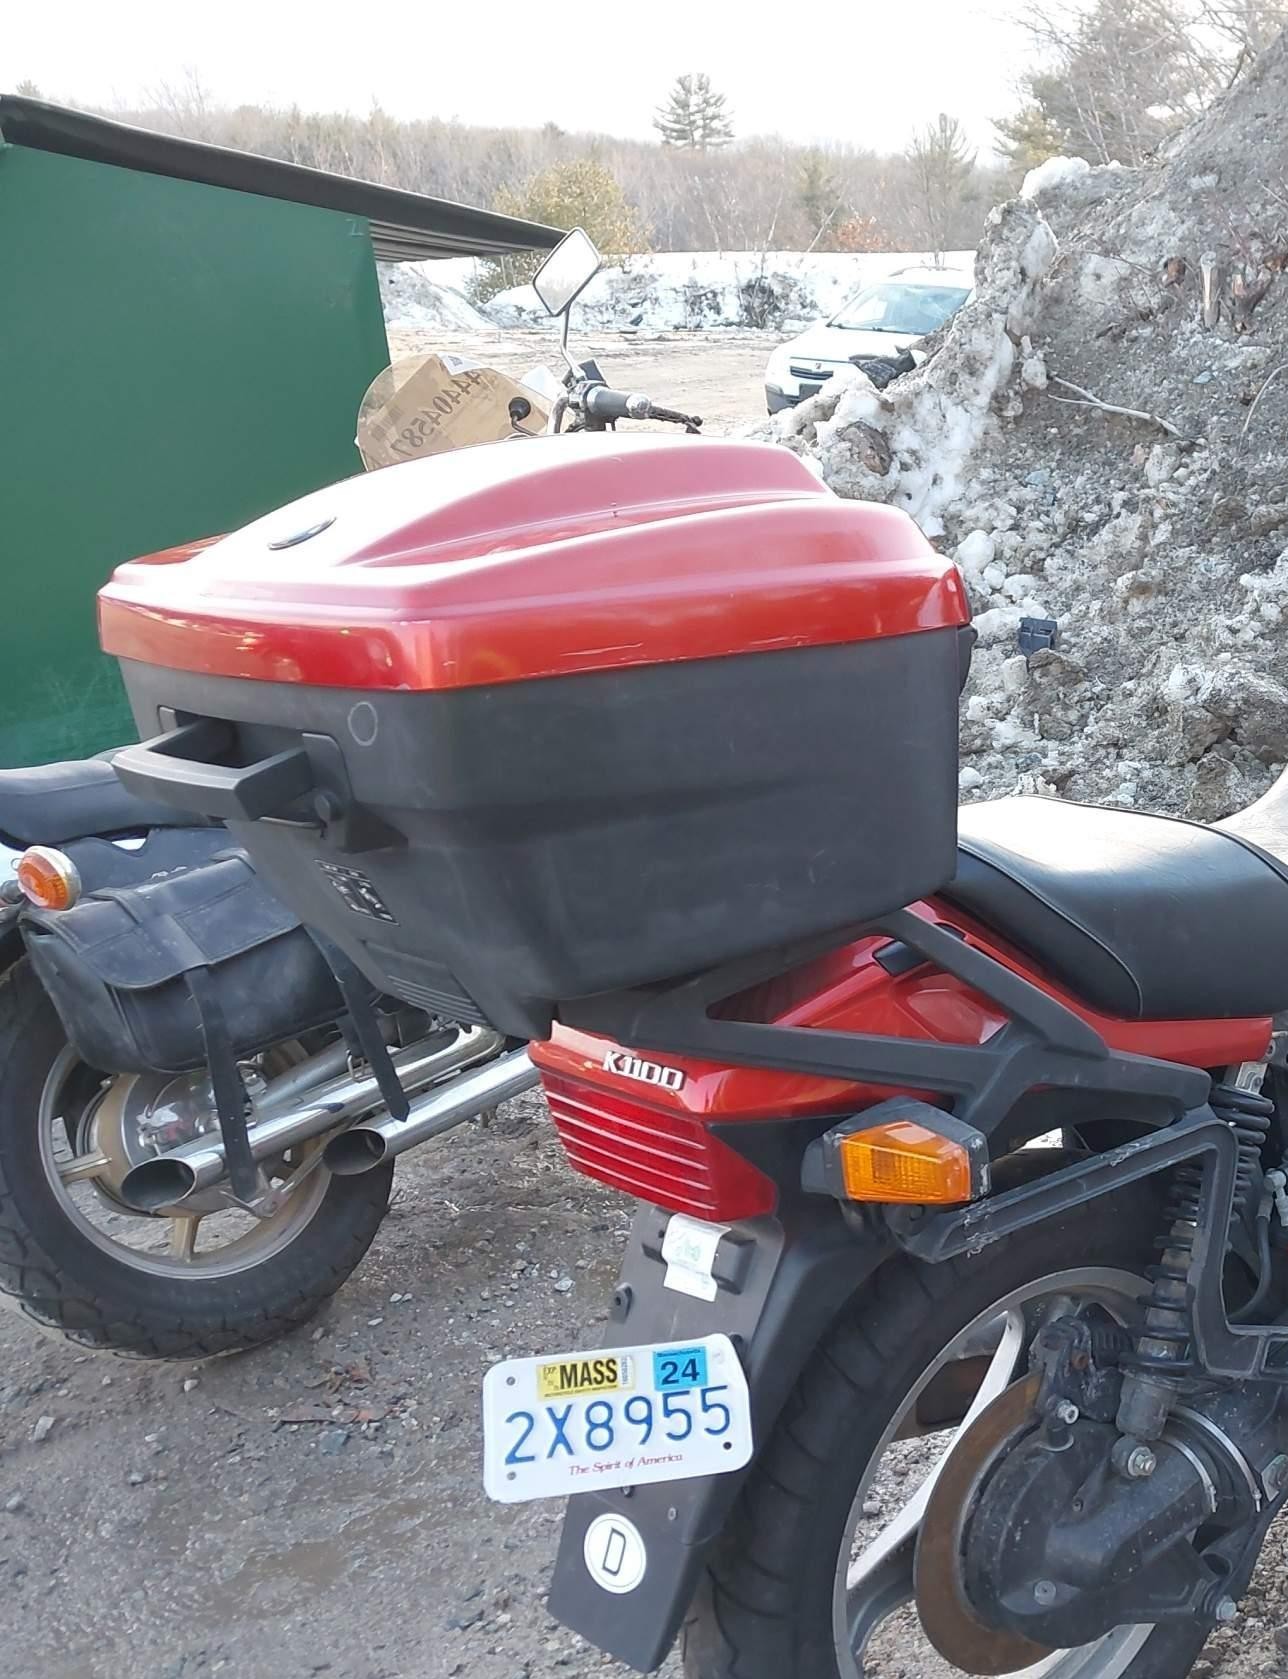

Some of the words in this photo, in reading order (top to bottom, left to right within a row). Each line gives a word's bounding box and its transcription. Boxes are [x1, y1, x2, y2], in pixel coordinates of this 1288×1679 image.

[602, 1051, 685, 1091] K1100
[559, 1358, 618, 1390] MASS
[660, 1357, 700, 1386] 24
[504, 1385, 731, 1466] 2X8955
[568, 1465, 590, 1475] The
[592, 1460, 621, 1473] Spirit
[624, 1457, 635, 1469] of
[637, 1453, 683, 1467] America
[602, 1527, 627, 1577] D
